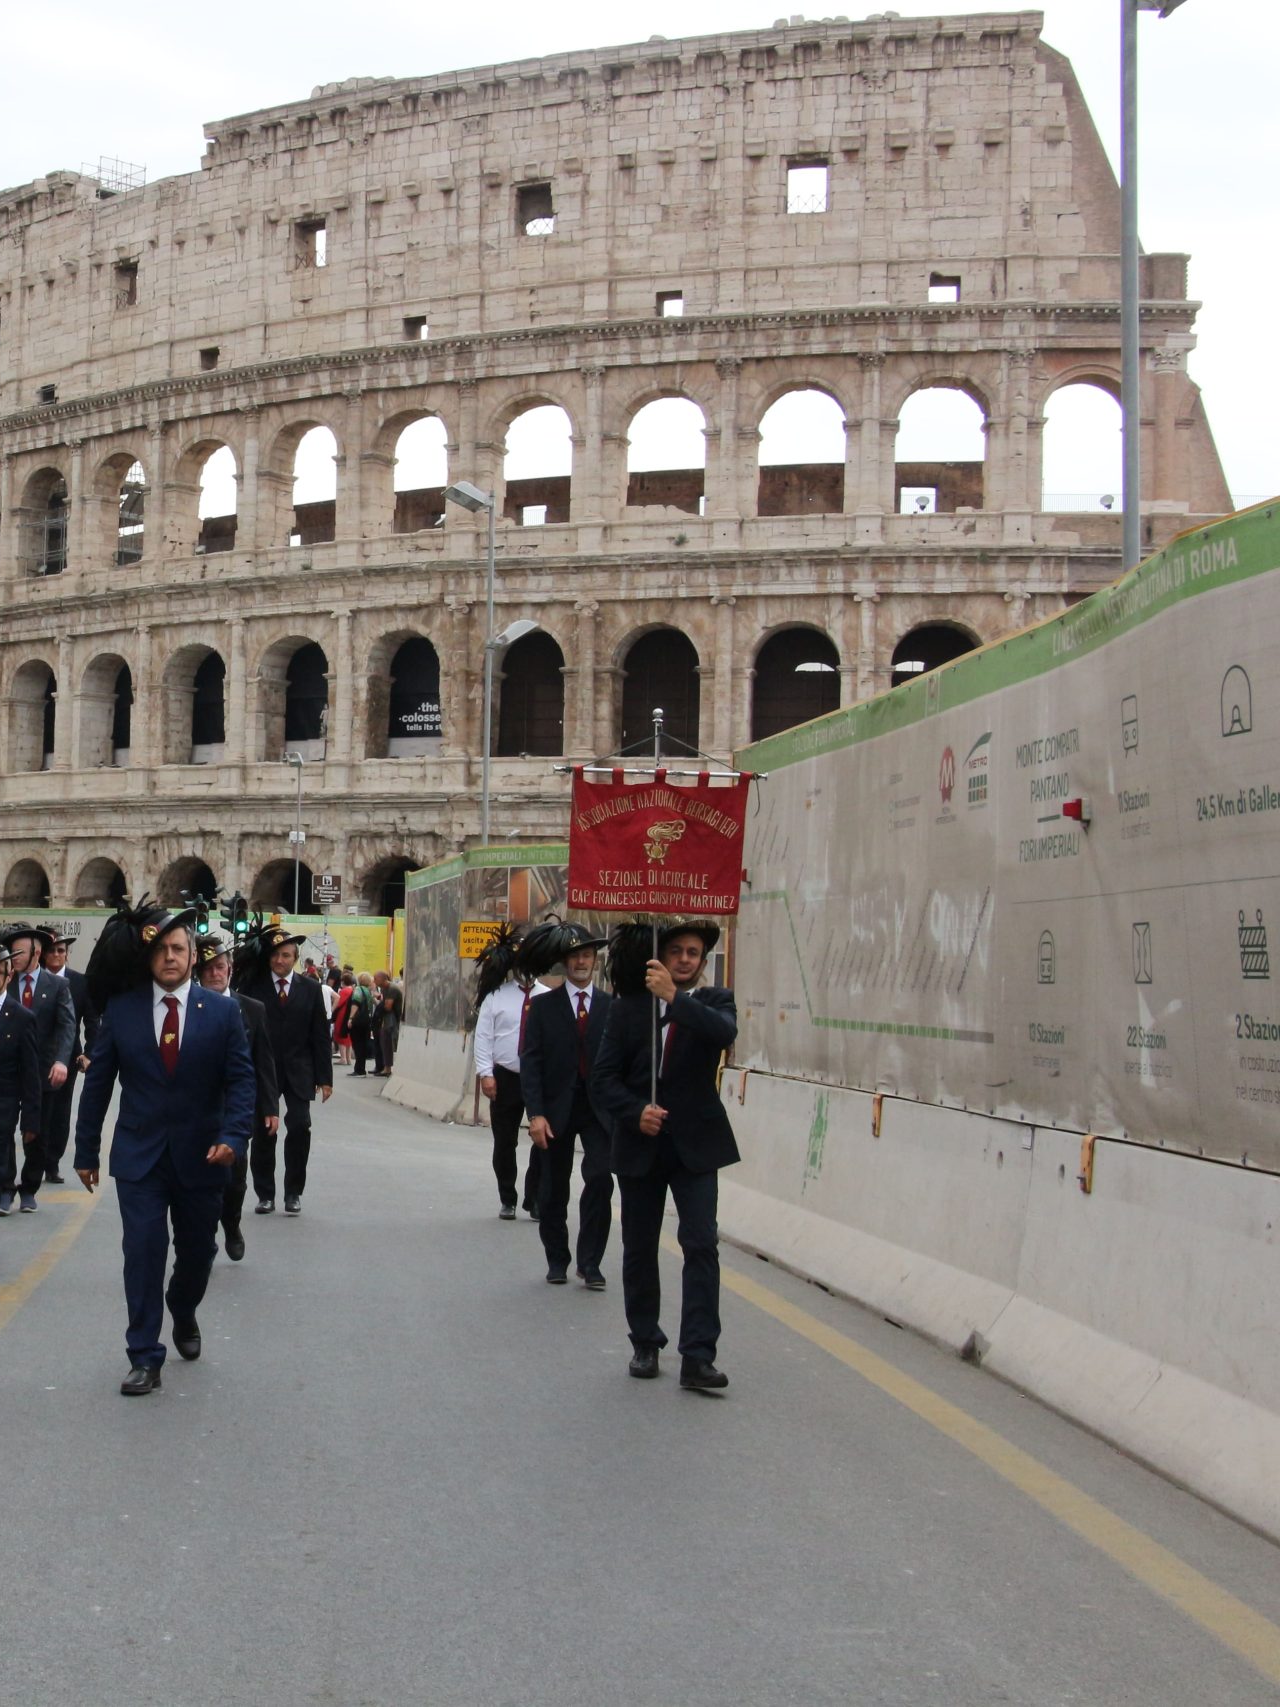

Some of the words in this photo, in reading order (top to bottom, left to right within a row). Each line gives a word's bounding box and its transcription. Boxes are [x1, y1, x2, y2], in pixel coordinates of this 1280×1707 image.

[1174, 555, 1186, 585] DI
[1190, 537, 1238, 580] ROMA
[1016, 739, 1043, 769] MONTE
[1045, 728, 1080, 763] COMPATRI
[1030, 773, 1069, 803] PANTANO
[1123, 785, 1151, 812] Stazioni
[576, 795, 635, 833] ASSOCIAZIONE
[637, 789, 684, 813] NAZIONALE
[685, 800, 741, 840] BERSAGLIERI
[1196, 795, 1216, 822] 24,5
[1218, 793, 1235, 817] Km
[1237, 788, 1247, 814] di
[1019, 835, 1036, 864] FORI
[1036, 831, 1081, 860] IMPERIALI
[599, 870, 644, 887] SEZIONE
[648, 869, 658, 886] DI
[660, 871, 709, 890] ACIREALE
[571, 889, 590, 903] CAP
[592, 890, 646, 906] FRANCESCO
[649, 890, 687, 907] GIUSEPPE
[689, 895, 735, 909] MARTINEZ
[463, 926, 501, 934] ATTENZIO
[465, 945, 473, 953] di
[1029, 1022, 1037, 1042] 13
[1037, 1022, 1065, 1045] Stazioni
[1127, 1025, 1138, 1048] 22
[1138, 1026, 1167, 1049] Stazioni
[1235, 1013, 1243, 1040] 2
[1244, 1013, 1280, 1042] Stazio
